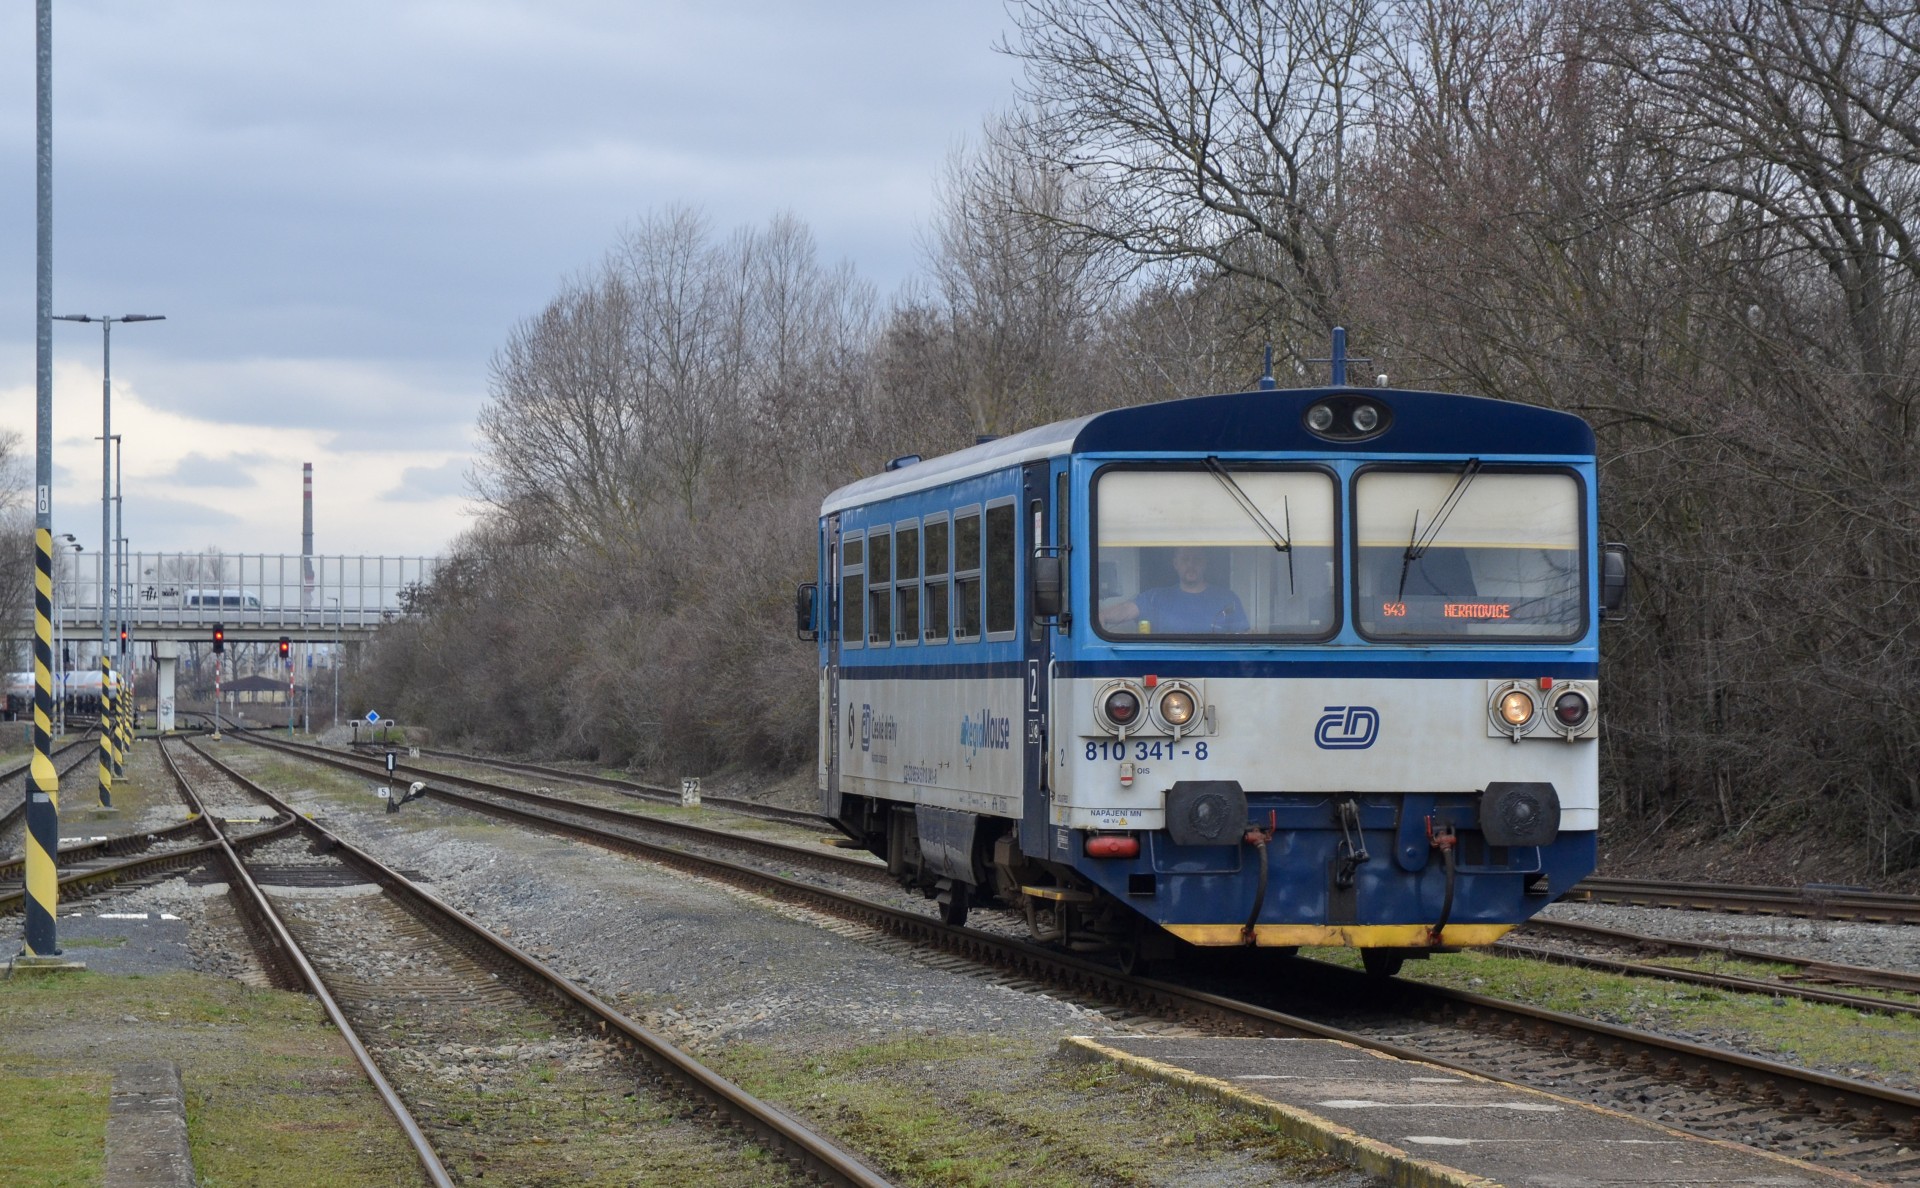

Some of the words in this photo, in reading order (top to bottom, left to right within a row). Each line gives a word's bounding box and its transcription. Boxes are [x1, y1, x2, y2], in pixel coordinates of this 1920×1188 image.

[1383, 603, 1407, 617] S43
[1444, 604, 1510, 618] NERATOVICE
[1031, 668, 1037, 703] 2
[1060, 748, 1065, 767] 2
[1085, 741, 1126, 761] 810
[1135, 741, 1209, 761] 341-8
[1136, 767, 1150, 775] OIS
[381, 788, 387, 797] 5
